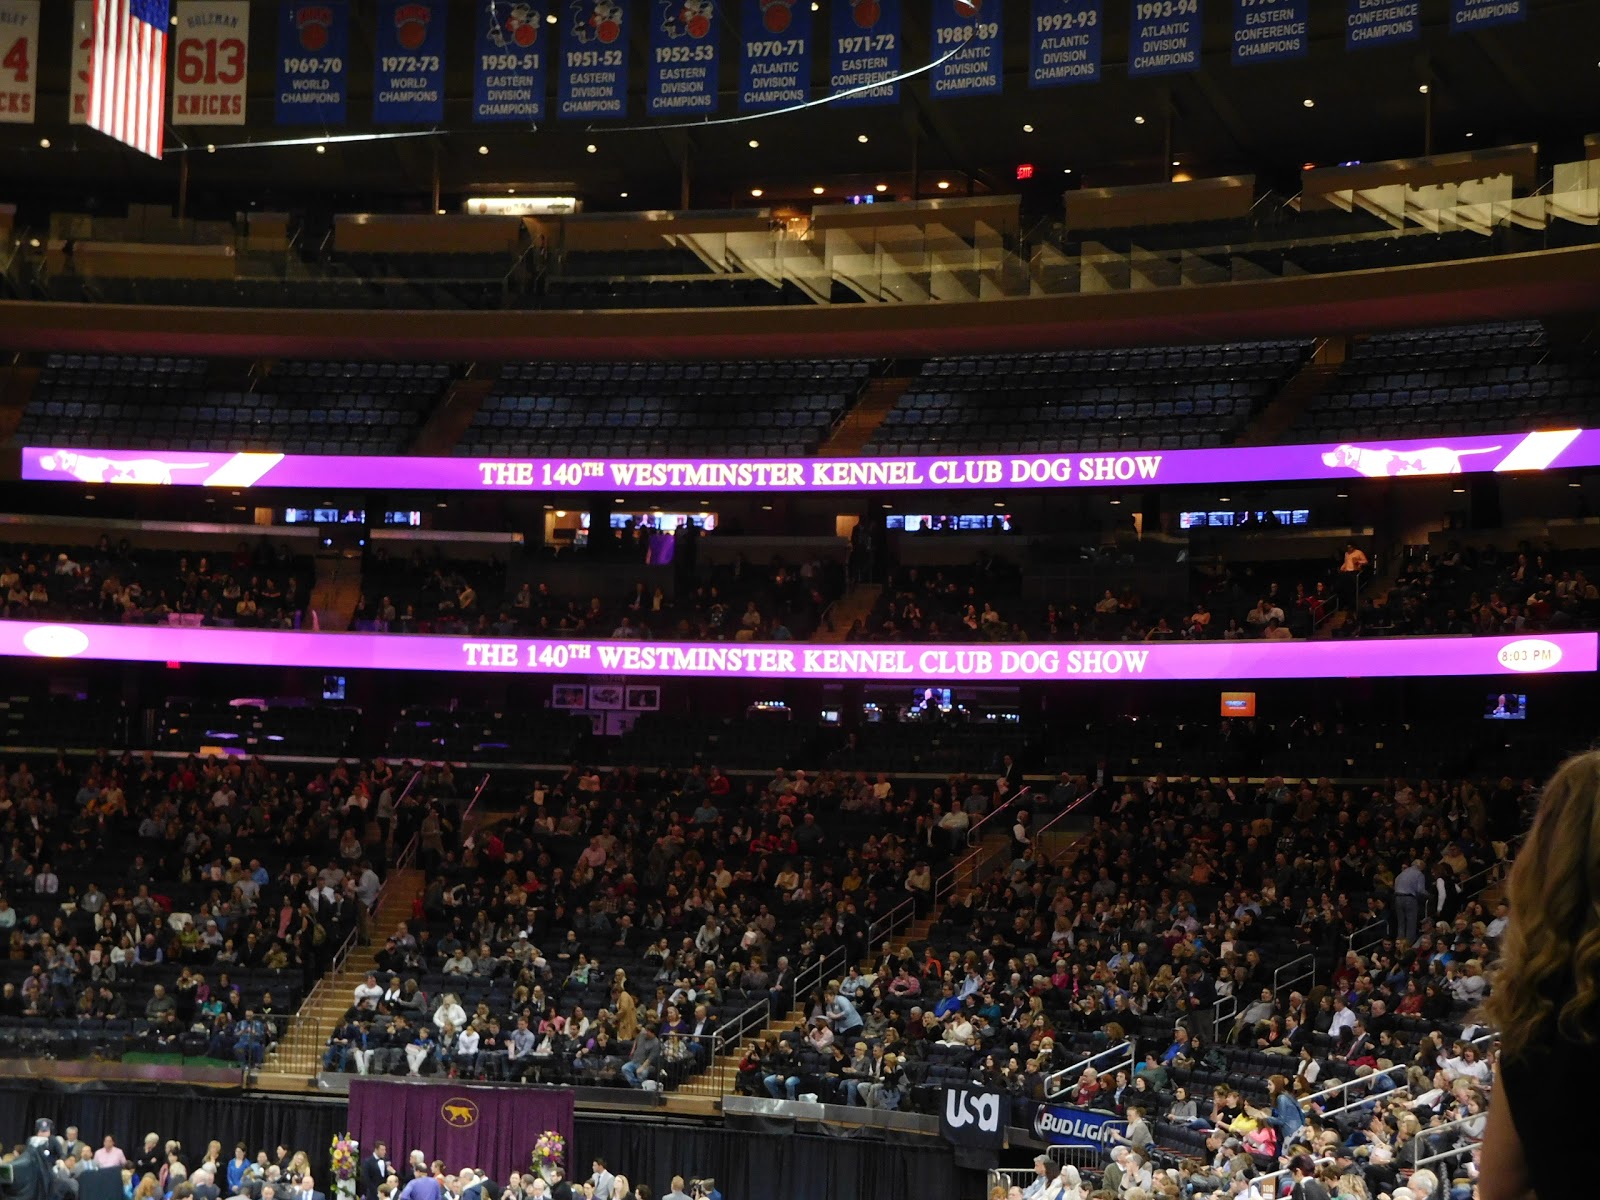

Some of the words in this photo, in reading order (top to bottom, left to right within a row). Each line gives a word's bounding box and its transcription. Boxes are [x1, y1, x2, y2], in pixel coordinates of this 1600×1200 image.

[1137, 0, 1197, 20] 1993-94
[1246, 9, 1294, 25] EASTERN
[1348, 4, 1418, 26] CONFERENCE
[1456, 1, 1520, 23] CHAMPIONS
[1037, 10, 1096, 32] 1992-93
[937, 23, 998, 44] 198889
[1141, 22, 1189, 37] ATLANTIC
[1235, 23, 1304, 41] CONFERENCE
[1352, 20, 1413, 41] CHAMPIONS
[747, 40, 804, 57] 1970-71
[838, 34, 895, 53] 1971-72
[1041, 35, 1089, 50] ATLANTIC
[1143, 38, 1186, 52] DIVISION
[1238, 39, 1300, 56] CHAMPIONS
[4, 37, 28, 82] 4
[177, 38, 245, 84] 613
[567, 50, 622, 67] 1951-52
[656, 45, 713, 63] 1952-53
[1043, 50, 1086, 64] DIVISION
[1134, 52, 1194, 68] CHAMPIONS
[284, 58, 342, 73] 1969-70
[382, 56, 439, 72] 1972-73
[482, 54, 539, 70] 1950-51
[751, 62, 799, 74] ATLANTIC
[842, 57, 887, 71] EASTERN
[945, 62, 988, 75] DIVISION
[570, 73, 615, 84] EASTERN
[660, 68, 706, 79] EASTERN
[832, 70, 898, 86] CONFERENCE
[1035, 63, 1094, 79] CHAMPIONS
[293, 79, 329, 90] WORLD
[391, 78, 427, 88] WORLD
[487, 76, 533, 87] EASTERN
[661, 82, 703, 93] DIVISION
[753, 77, 796, 89] DIVISION
[936, 75, 996, 91] CHAMPIONS
[281, 92, 340, 103] CHAMPIONS
[379, 91, 437, 102] CHAMPIONS
[488, 90, 530, 100] DIVISION
[572, 87, 613, 97] DIVISION
[744, 90, 804, 103] CHAMPIONS
[178, 95, 241, 115] KNICKS
[479, 103, 538, 115] CHAMPIONS
[563, 100, 620, 112] CHAMPIONS
[653, 95, 711, 108] CHAMPIONS
[479, 463, 534, 485] THE
[542, 462, 604, 485] 140TH
[610, 463, 805, 486] WESTMINSTER
[812, 461, 923, 485] KENNEL
[929, 460, 1002, 484] CLUB
[1010, 459, 1071, 483] DOG
[1079, 456, 1162, 480] SHOW
[463, 643, 518, 667] THE
[527, 644, 591, 668] 140TH
[597, 646, 796, 672] WESTMINSTER
[803, 650, 913, 673] KENNEL
[919, 650, 992, 673] CLUB
[1000, 651, 1060, 673] DOG
[1067, 650, 1149, 673] SHOW
[1502, 651, 1527, 661] 8:03
[1534, 650, 1551, 660] PM
[1041, 1113, 1073, 1135] BUD
[1262, 1184, 1274, 1192] 108
